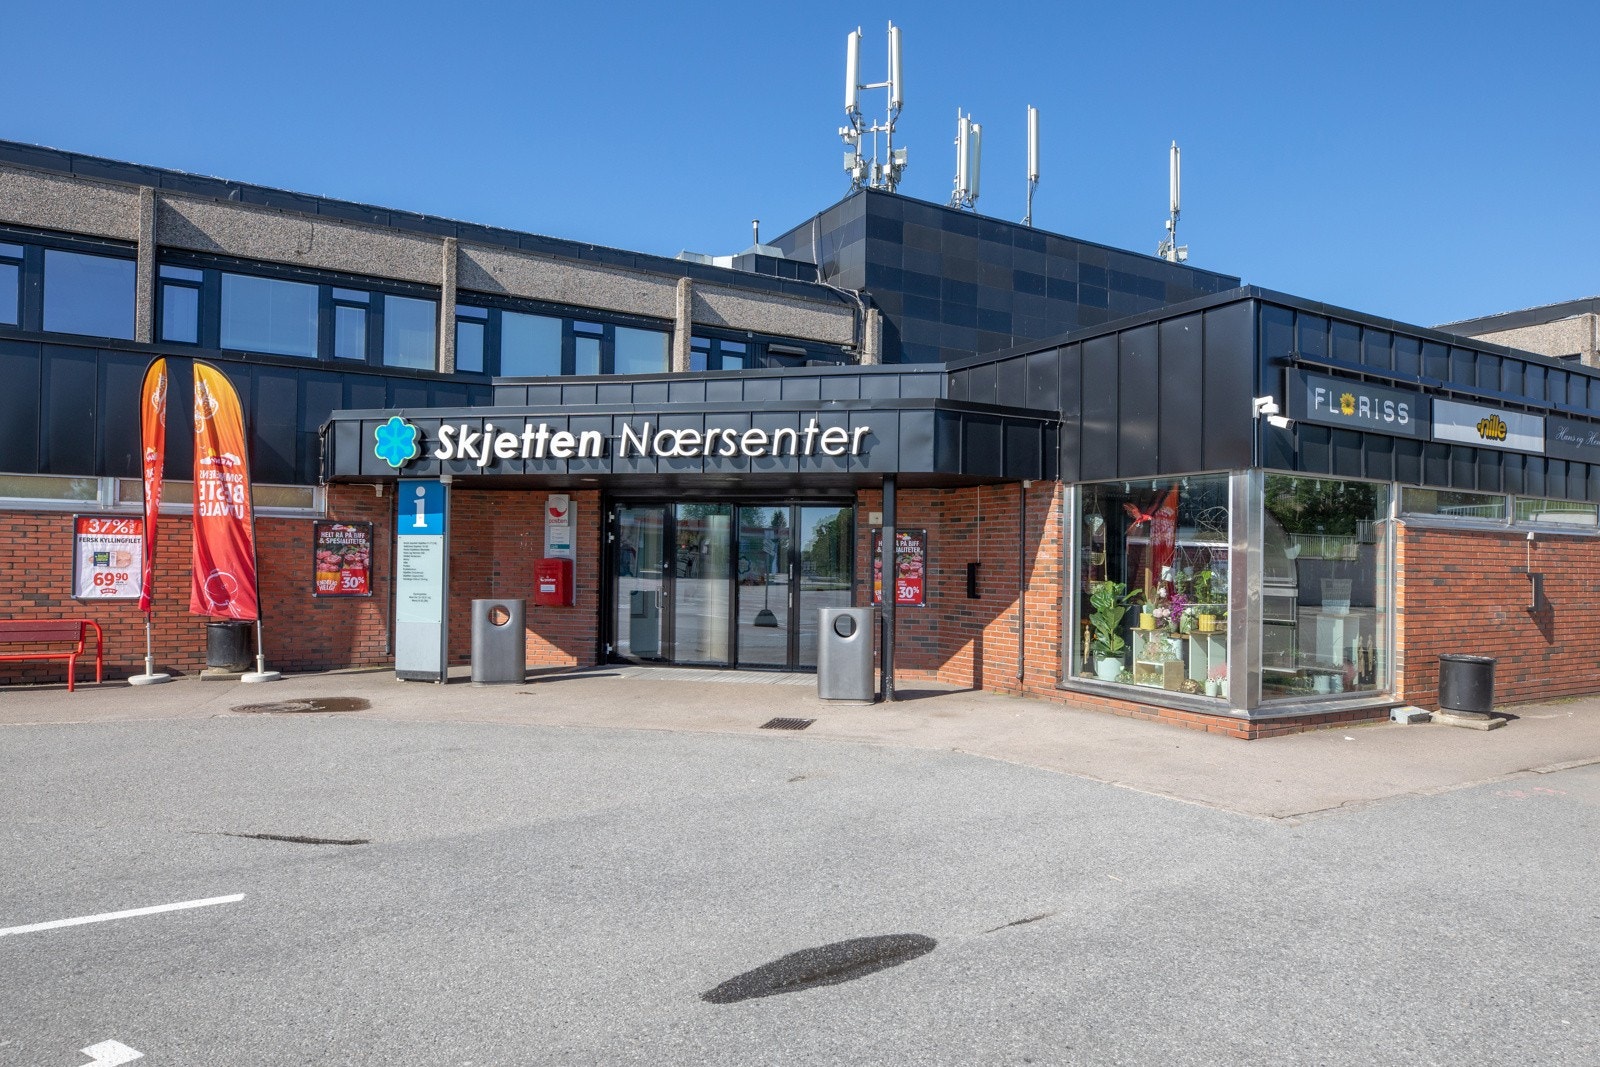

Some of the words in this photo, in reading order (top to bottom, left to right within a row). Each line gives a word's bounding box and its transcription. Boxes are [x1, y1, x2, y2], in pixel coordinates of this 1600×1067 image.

[1315, 387, 1409, 424] FLORISS
[1478, 414, 1507, 441] nille
[1555, 426, 1575, 442] Hans
[1576, 437, 1584, 448] og
[434, 423, 602, 467] Skjetten
[619, 418, 870, 458] Nærsenter
[88, 518, 129, 534] 37%
[100, 536, 141, 544] KYLLINGFILET
